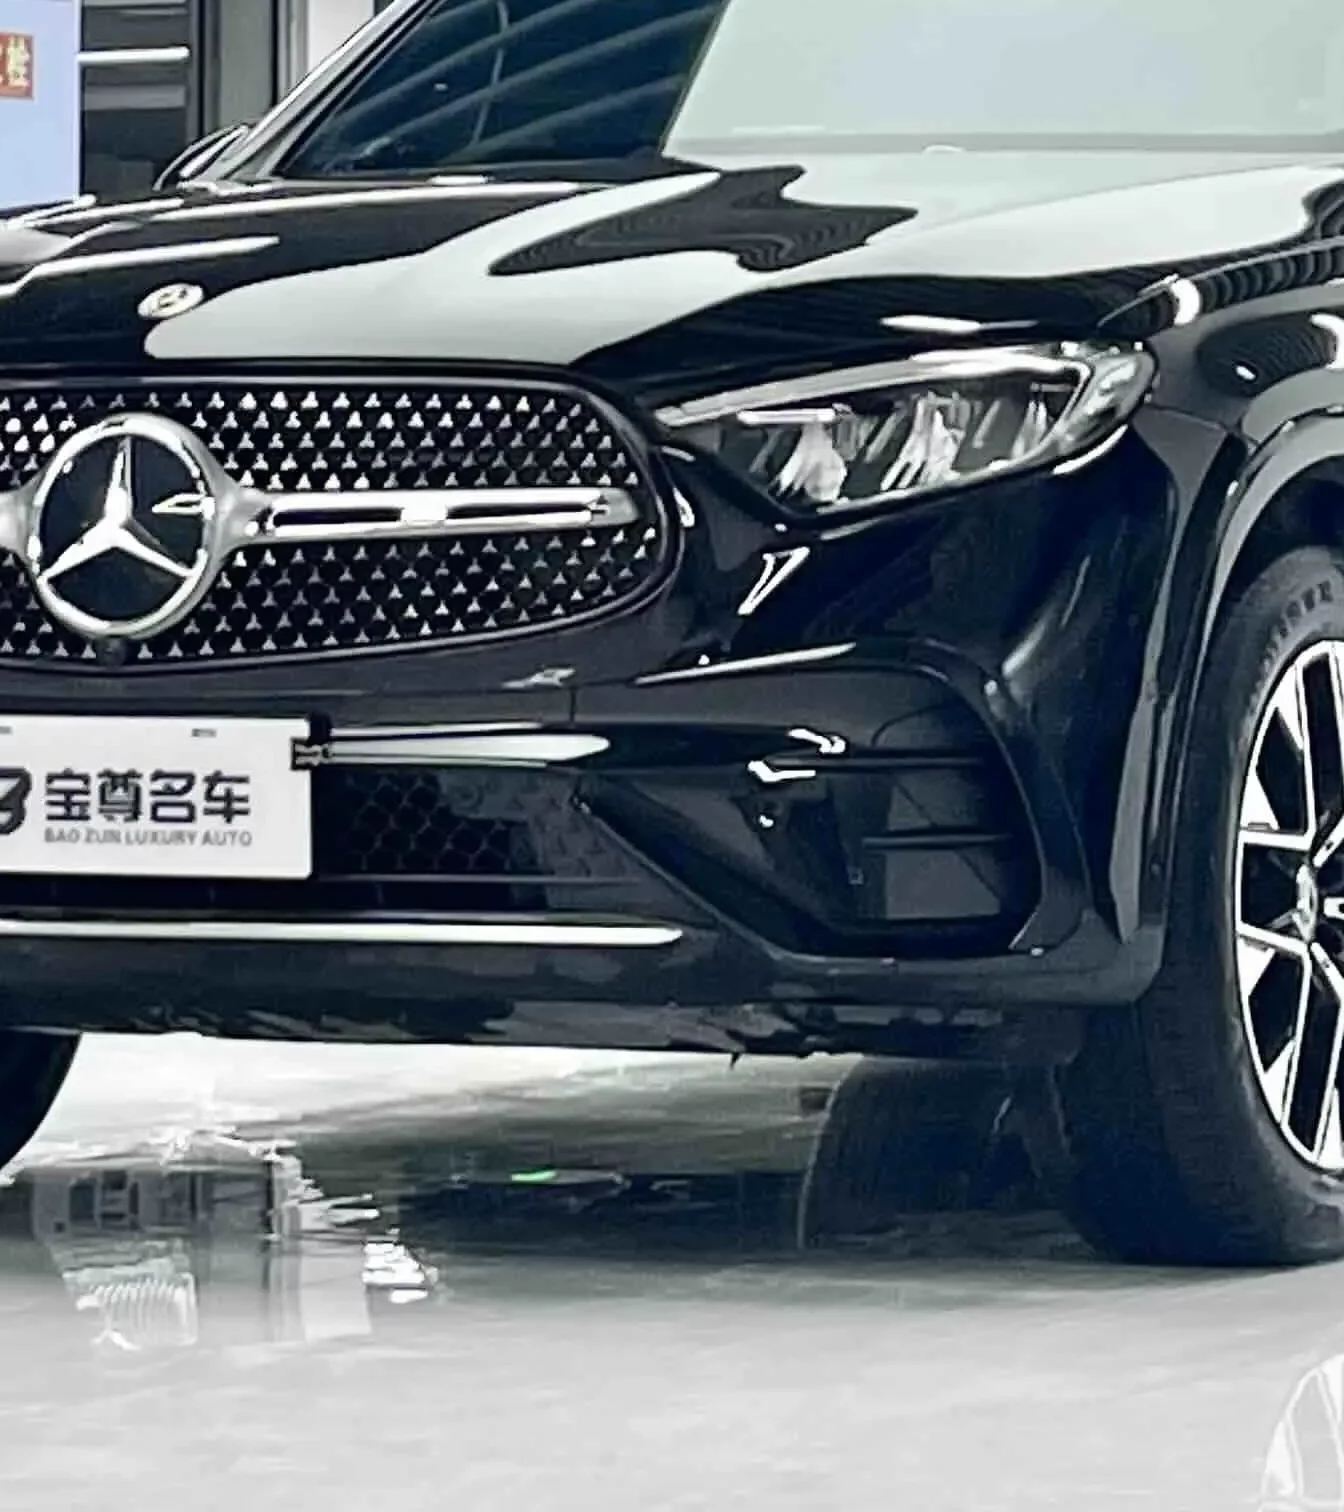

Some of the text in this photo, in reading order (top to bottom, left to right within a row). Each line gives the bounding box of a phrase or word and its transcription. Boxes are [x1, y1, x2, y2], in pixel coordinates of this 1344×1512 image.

[45, 768, 251, 824] 宝尊名车
[44, 828, 253, 847] BAO ZUN LUXURY AUTO
